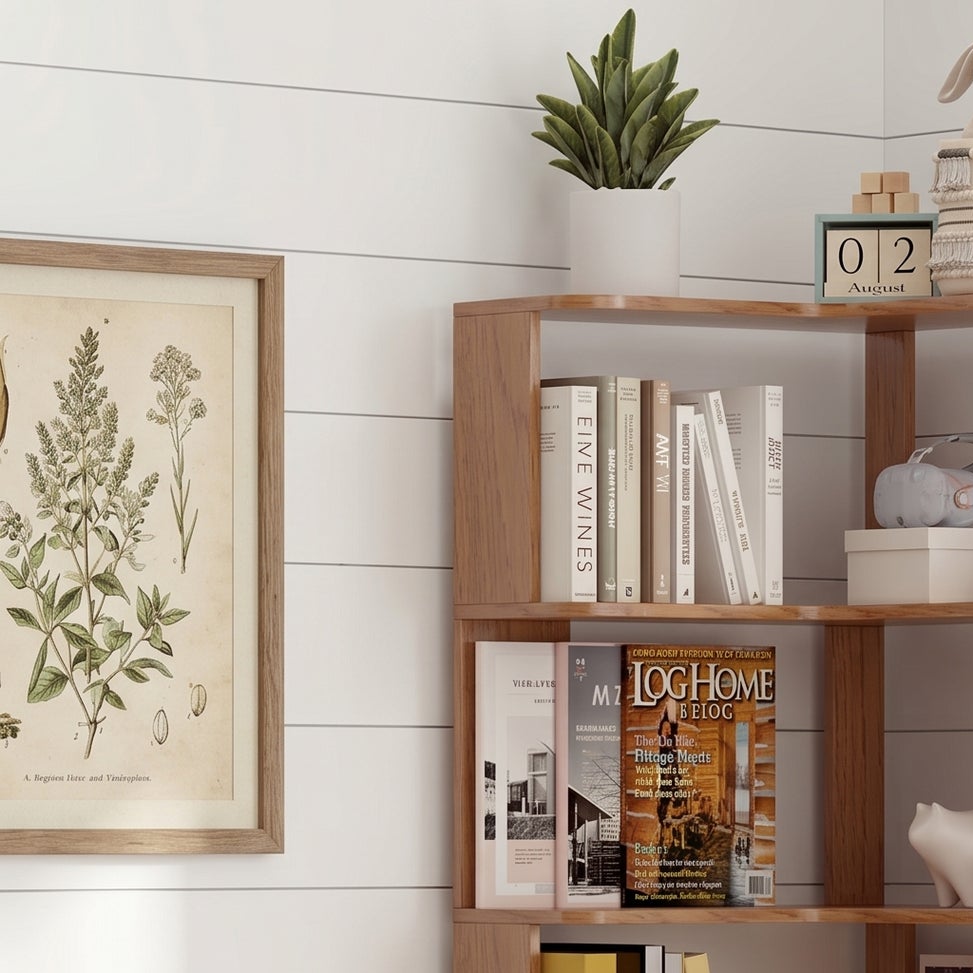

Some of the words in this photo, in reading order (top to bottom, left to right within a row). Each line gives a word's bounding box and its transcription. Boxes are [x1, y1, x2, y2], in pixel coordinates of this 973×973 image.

[848, 282, 906, 296] August
[577, 486, 593, 572] WINES
[89, 774, 103, 782] and
